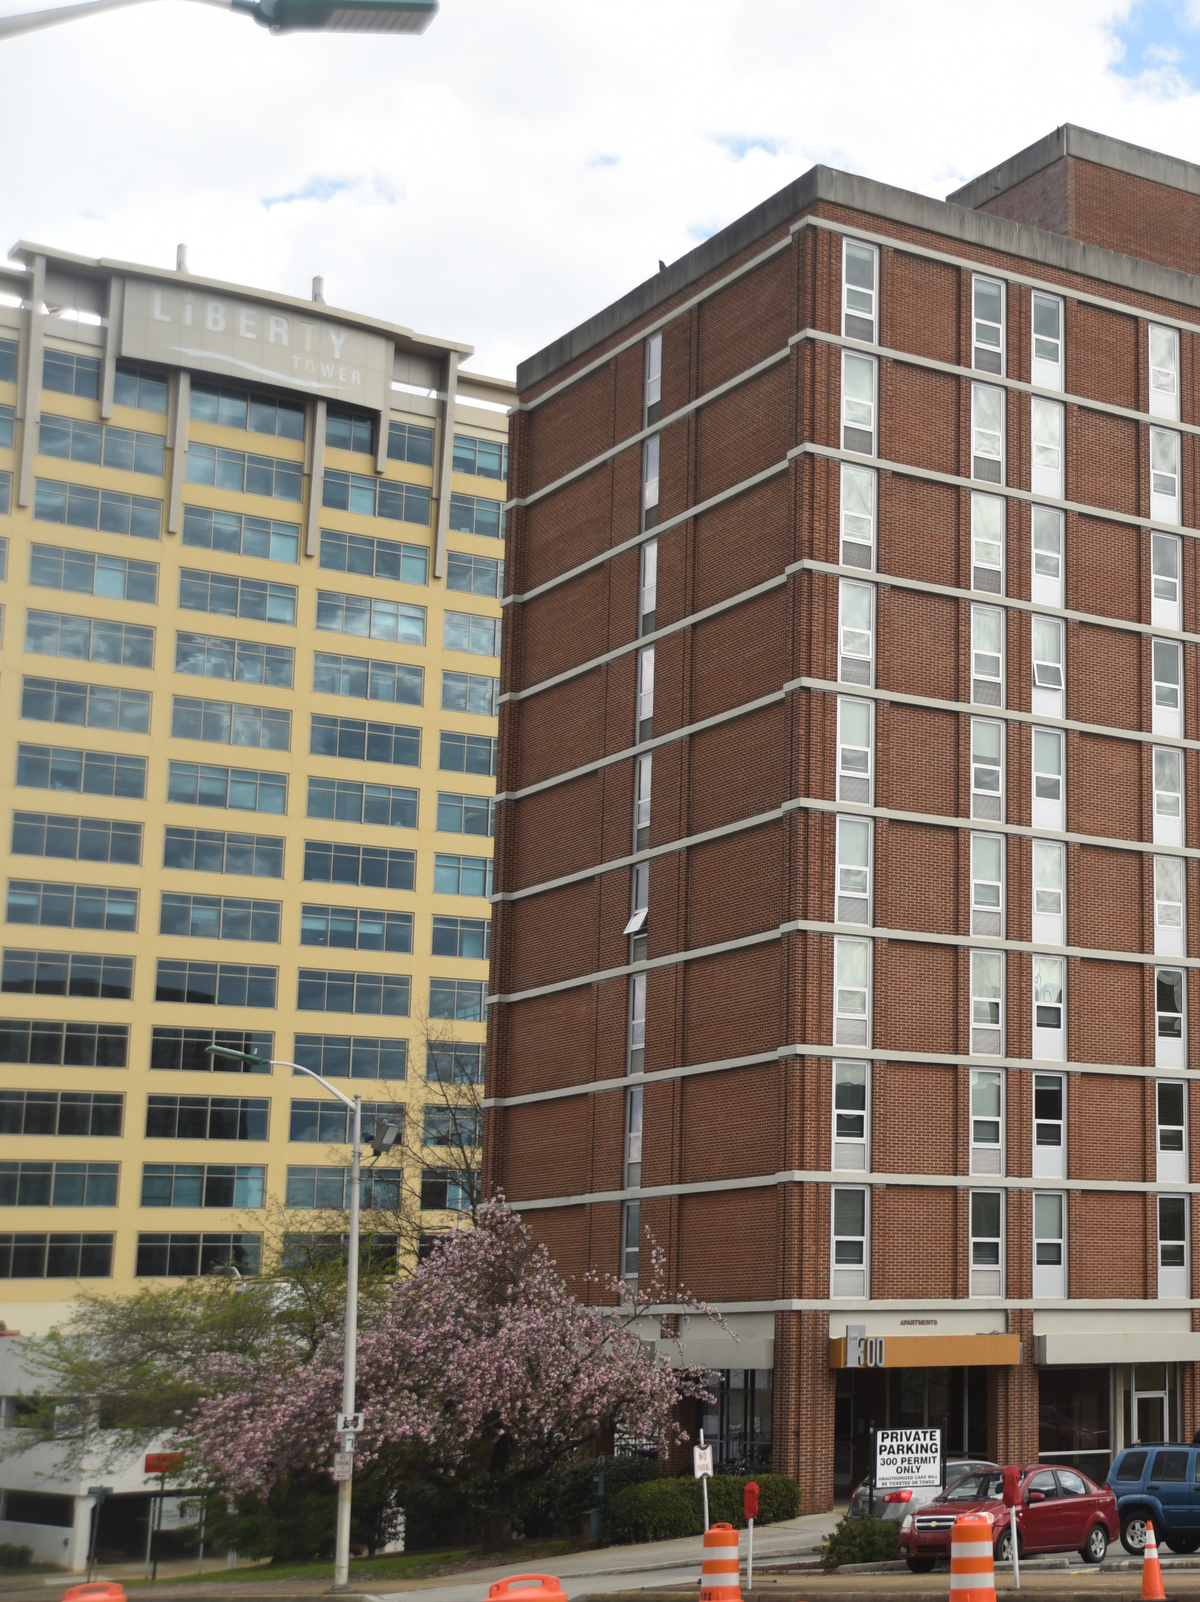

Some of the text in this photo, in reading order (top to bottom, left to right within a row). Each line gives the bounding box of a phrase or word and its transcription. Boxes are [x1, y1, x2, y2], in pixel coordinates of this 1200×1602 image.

[292, 355, 362, 386] TOWER
[858, 1337, 885, 1367] 300
[881, 1431, 937, 1442] PRIVATE
[879, 1443, 939, 1455] PARKING
[699, 1451, 707, 1460] NO
[880, 1456, 937, 1466] 300 PERMIT
[896, 1465, 921, 1474] ONLY
